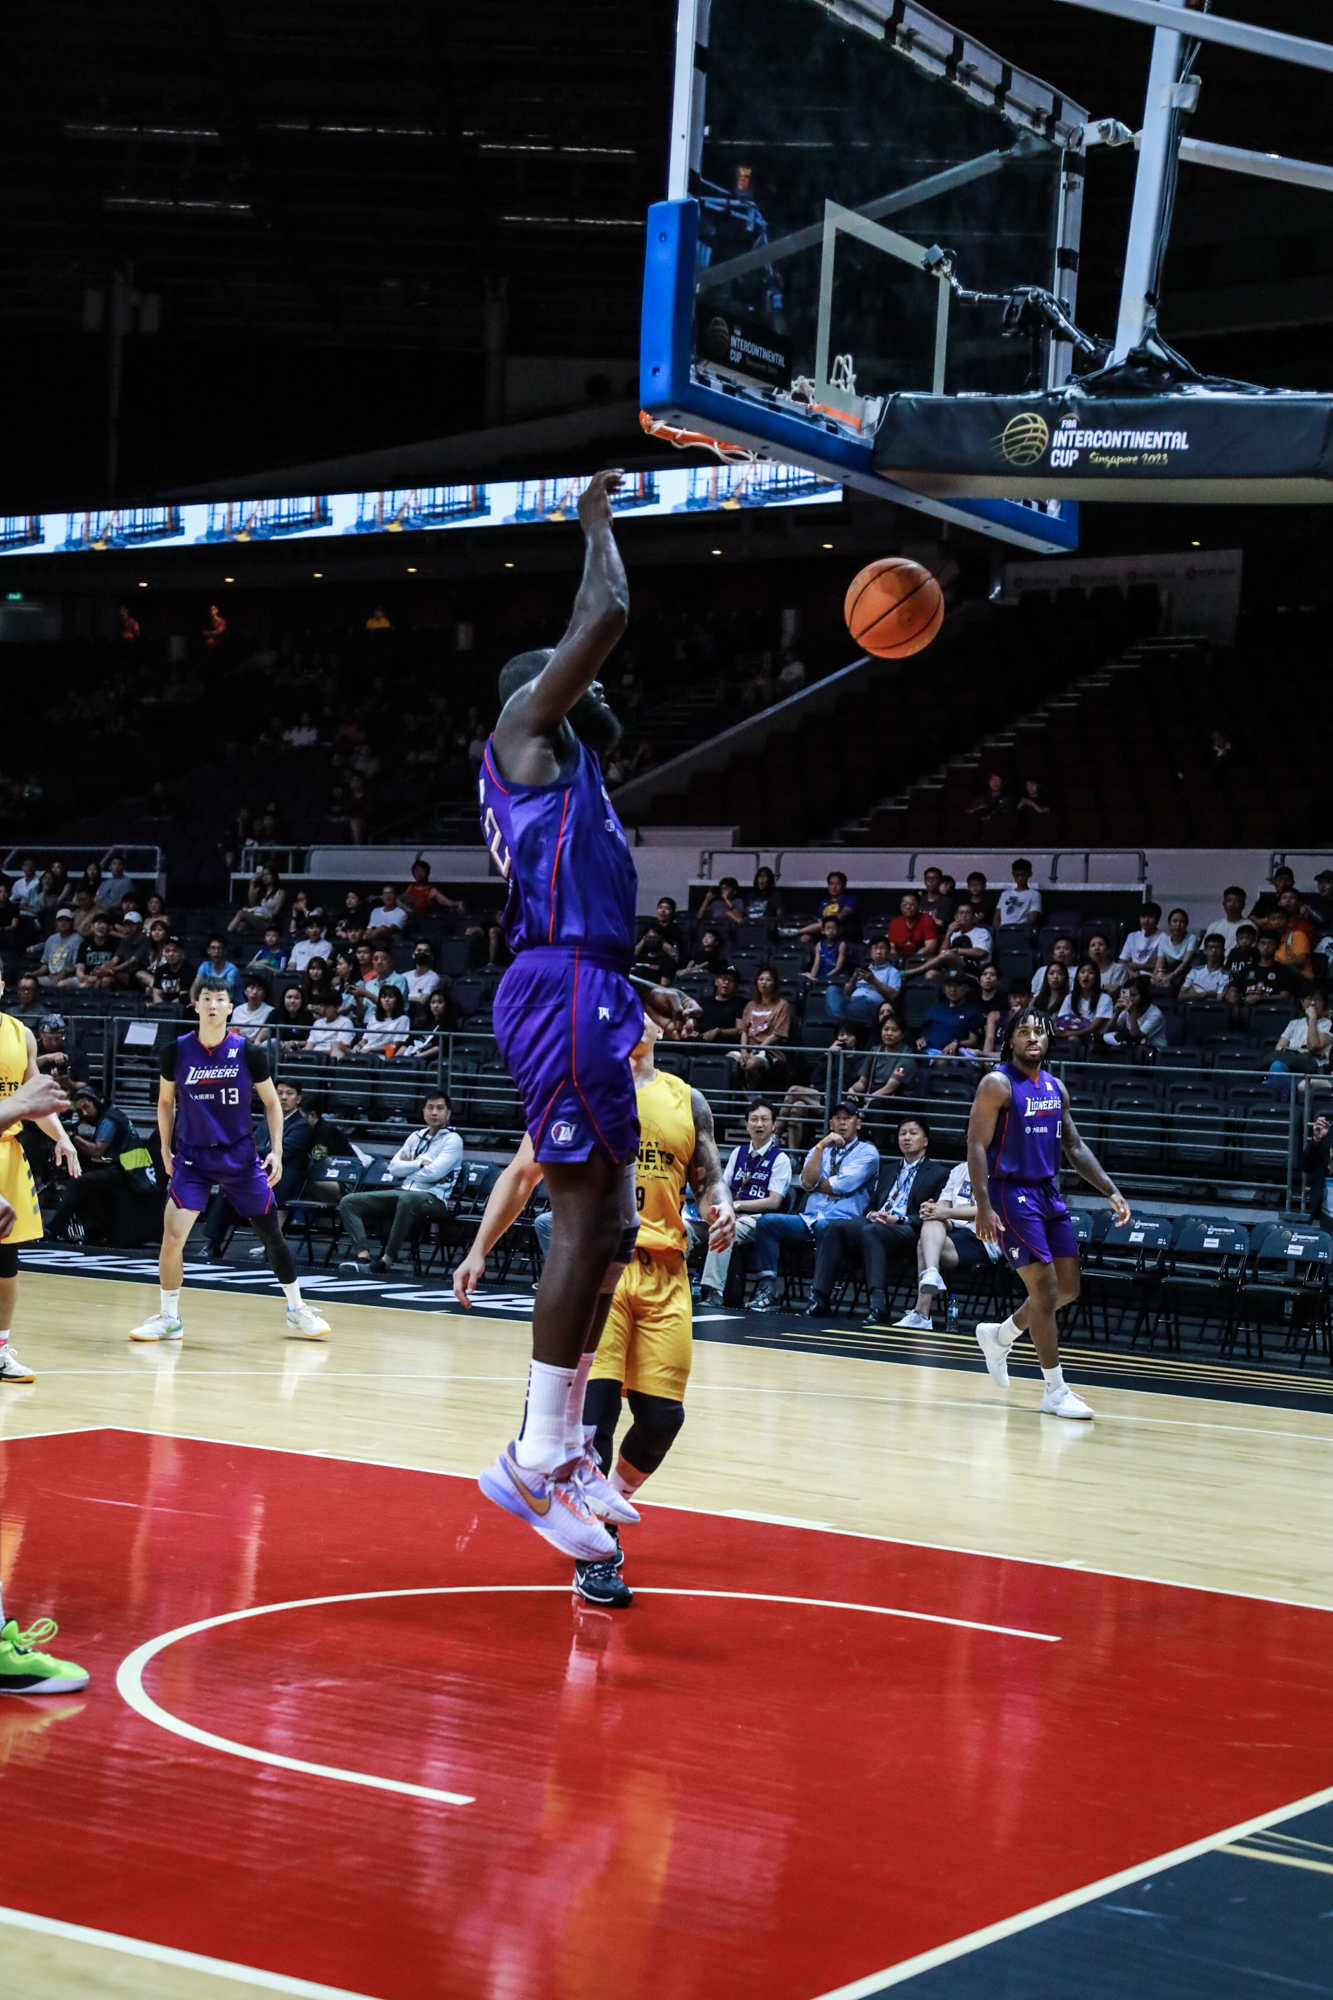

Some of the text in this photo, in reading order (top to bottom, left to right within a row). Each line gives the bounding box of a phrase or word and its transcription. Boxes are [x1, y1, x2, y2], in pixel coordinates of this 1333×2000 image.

[729, 349, 742, 363] CUP
[731, 335, 786, 368] INTERCONTINENTAL
[1061, 419, 1077, 429] FIBA
[1052, 430, 1189, 450] INTERCONTINENTAL
[1050, 450, 1168, 469] CUP Singapore 2023
[219, 1087, 240, 1105] 13
